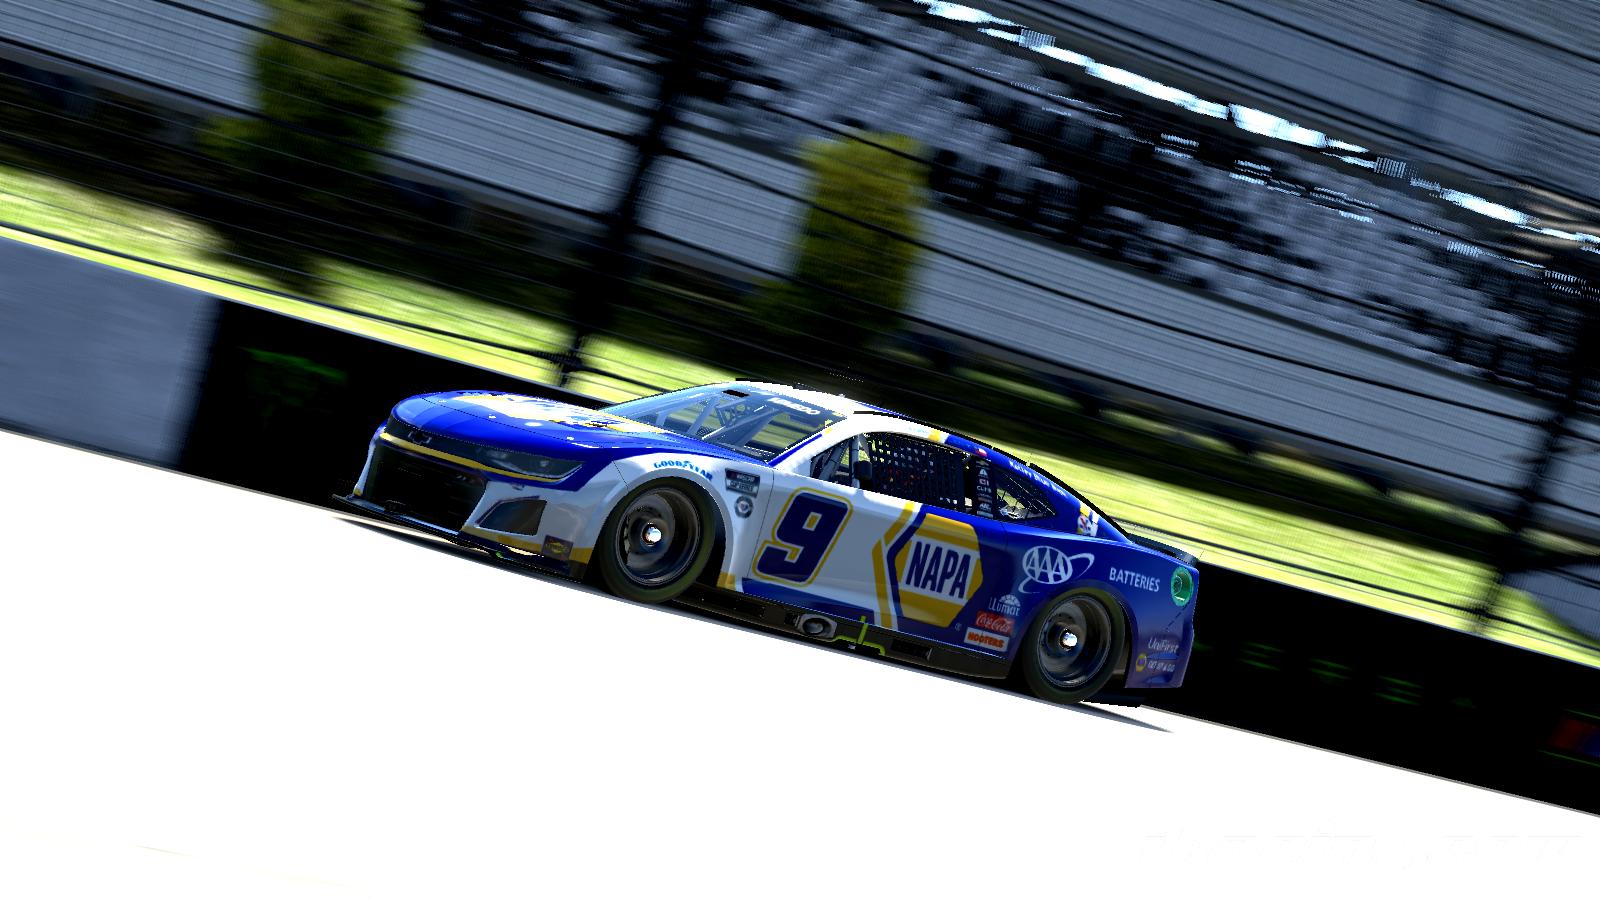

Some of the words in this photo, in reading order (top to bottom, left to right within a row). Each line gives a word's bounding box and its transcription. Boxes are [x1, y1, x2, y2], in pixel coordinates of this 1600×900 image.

[654, 460, 713, 481] GOODYEAR
[754, 489, 851, 586] 9
[905, 541, 971, 599] NAPA
[1024, 547, 1070, 583] AAA
[1109, 567, 1161, 592] BATTERIES
[967, 631, 1005, 648] HOOTERS
[1147, 636, 1179, 653] UniFirst
